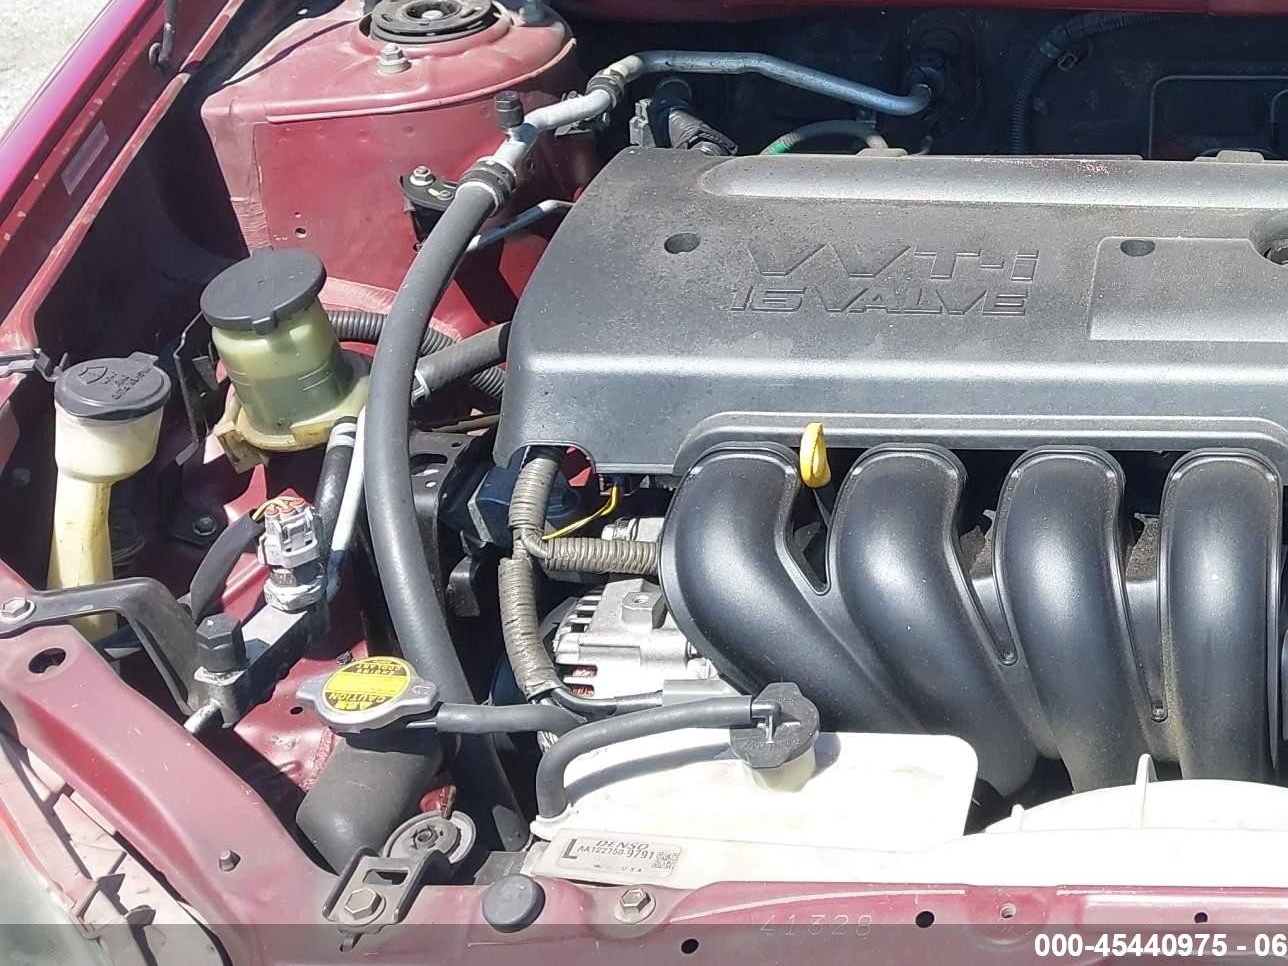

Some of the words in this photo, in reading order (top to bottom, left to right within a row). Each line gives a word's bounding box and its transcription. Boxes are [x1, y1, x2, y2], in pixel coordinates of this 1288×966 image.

[728, 284, 807, 313] 16
[815, 287, 1029, 317] VALVE
[328, 692, 387, 703] CAUTION
[561, 838, 578, 860] L
[596, 840, 649, 850] DENSO
